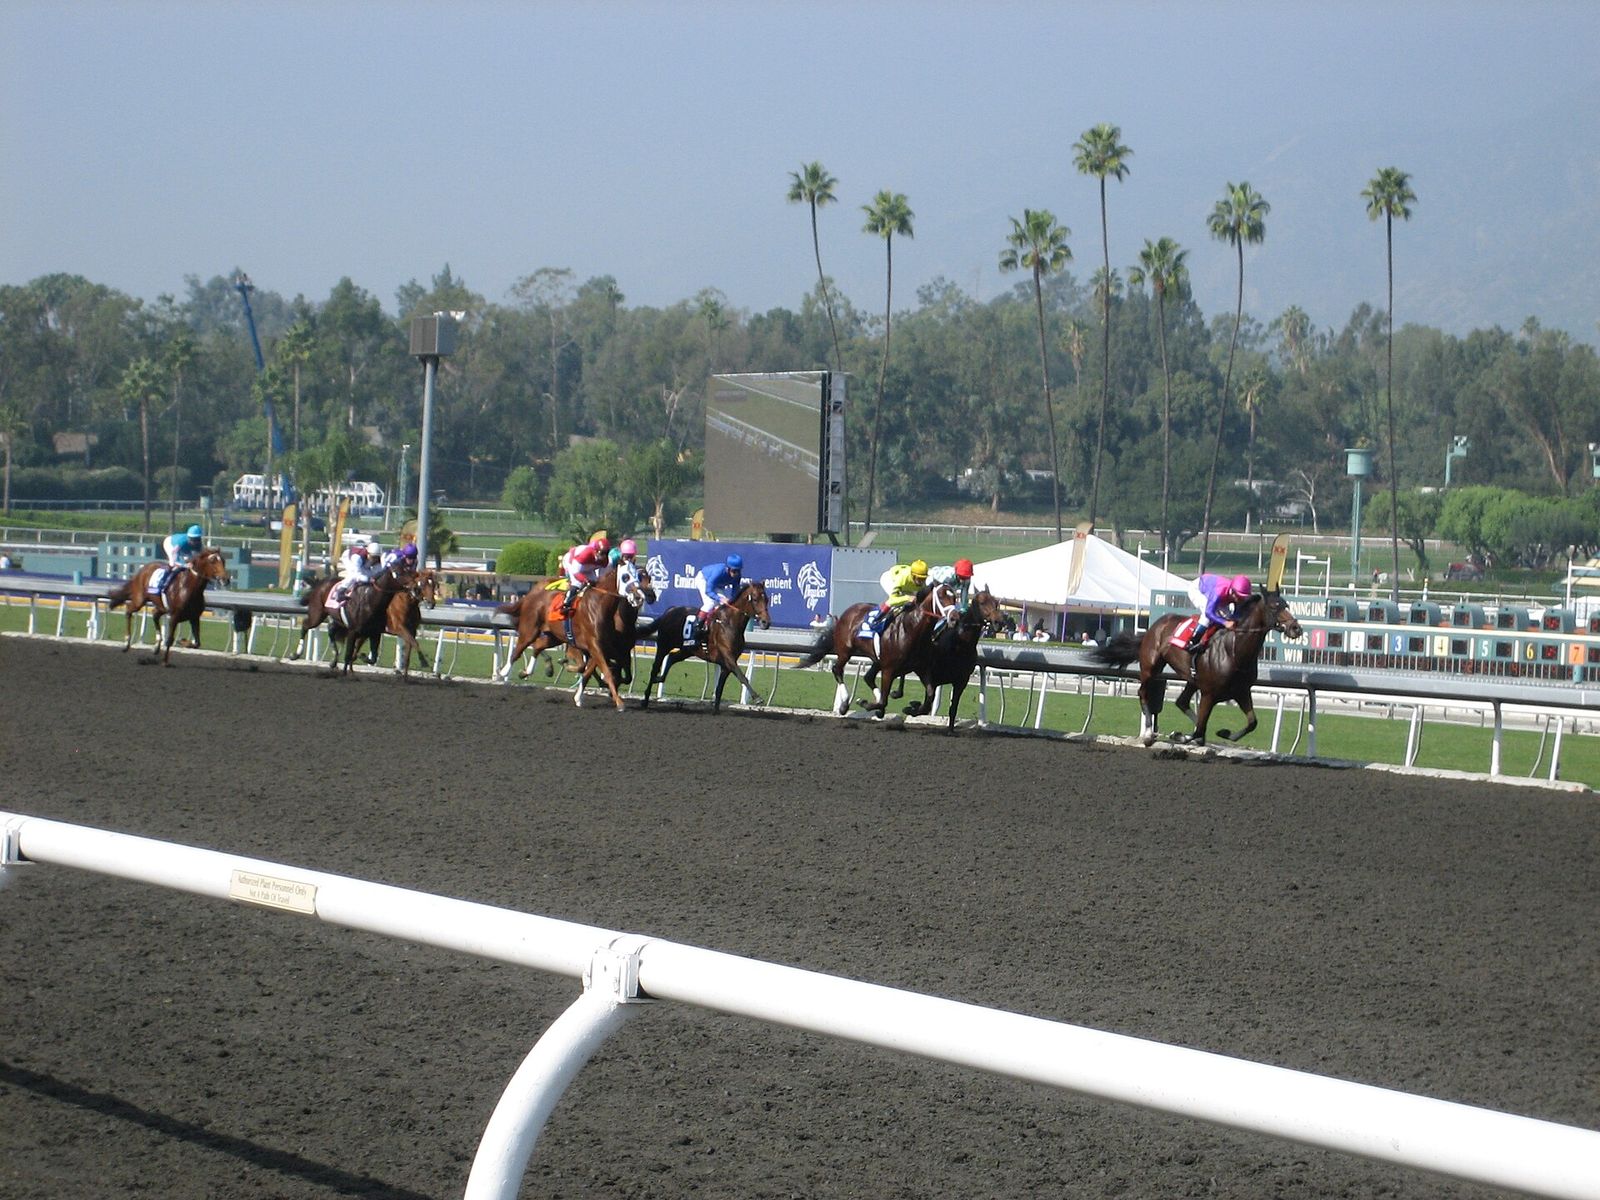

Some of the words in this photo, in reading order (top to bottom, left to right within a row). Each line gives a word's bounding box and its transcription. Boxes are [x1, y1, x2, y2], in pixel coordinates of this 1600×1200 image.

[674, 573, 697, 589] Emira
[764, 577, 792, 590] entient
[770, 592, 782, 607] jet
[1288, 601, 1311, 617] RNING
[1311, 602, 1327, 618] LINE
[1315, 631, 1321, 648] 1
[1394, 635, 1402, 652] 3
[1284, 648, 1303, 662] WIN
[1481, 640, 1489, 657] 5
[1526, 642, 1534, 660] 6
[1573, 646, 1580, 662] 7
